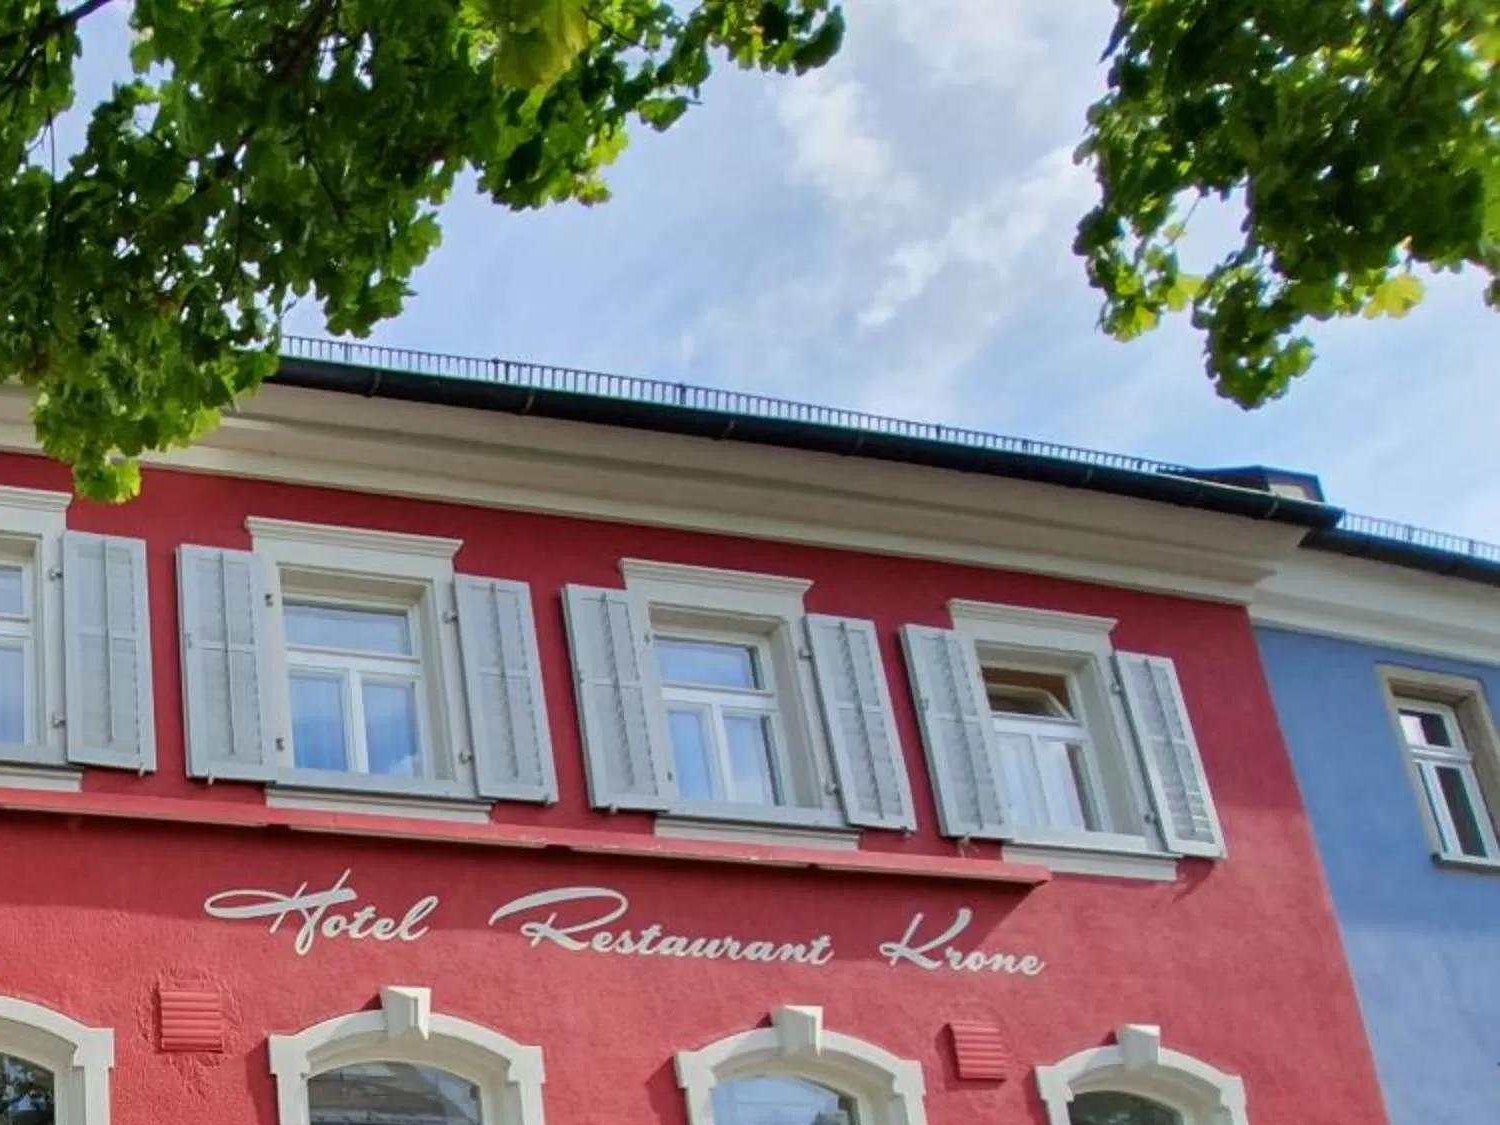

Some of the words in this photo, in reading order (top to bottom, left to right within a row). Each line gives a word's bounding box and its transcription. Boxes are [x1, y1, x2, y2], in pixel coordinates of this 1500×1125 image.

[204, 867, 439, 956] Hotel
[488, 885, 835, 966] Restaurant
[878, 907, 1047, 976] Krone
